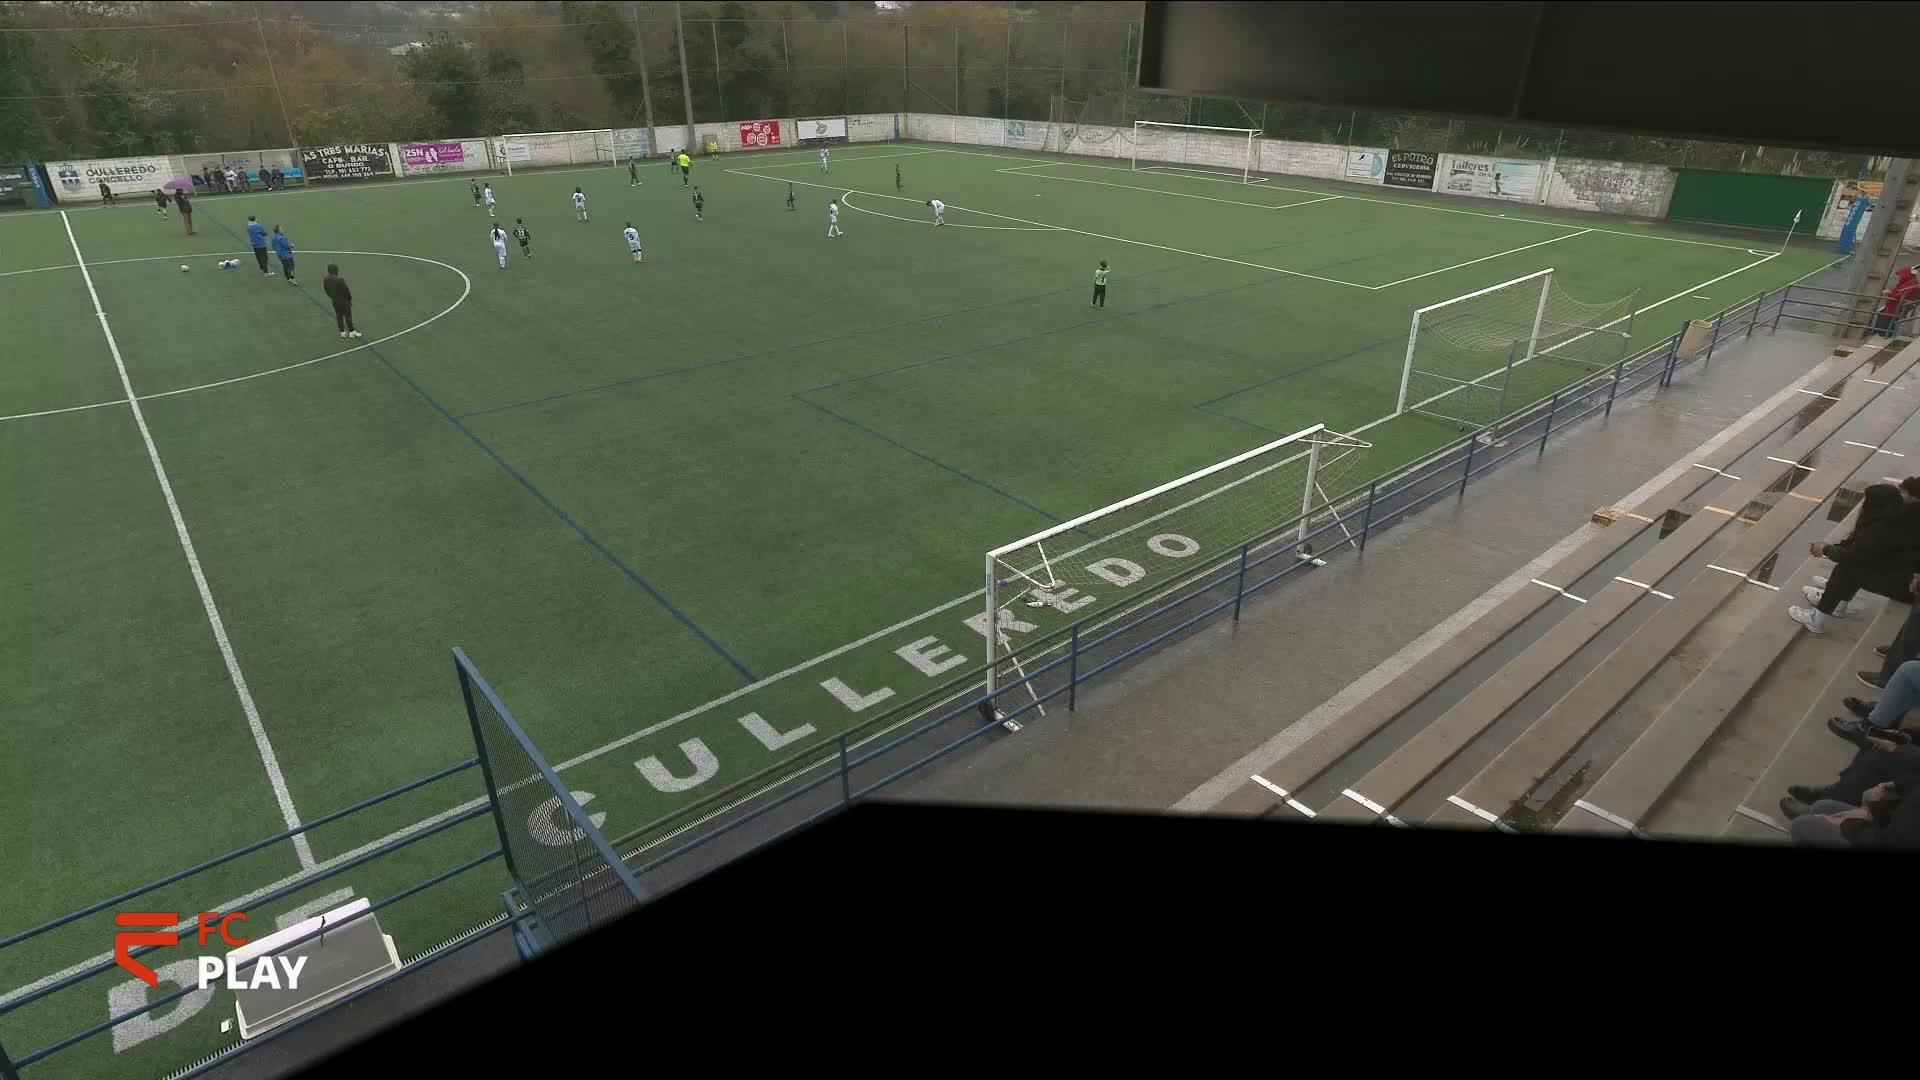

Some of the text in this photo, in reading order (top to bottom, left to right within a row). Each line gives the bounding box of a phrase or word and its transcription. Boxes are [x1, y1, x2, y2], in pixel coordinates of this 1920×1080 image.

[317, 146, 341, 157] TRES
[343, 145, 385, 156] MARIAS
[405, 148, 423, 157] 25N
[349, 155, 368, 163] BAR
[1391, 152, 1434, 165] EL POTRO
[88, 174, 143, 184] CONCELLO
